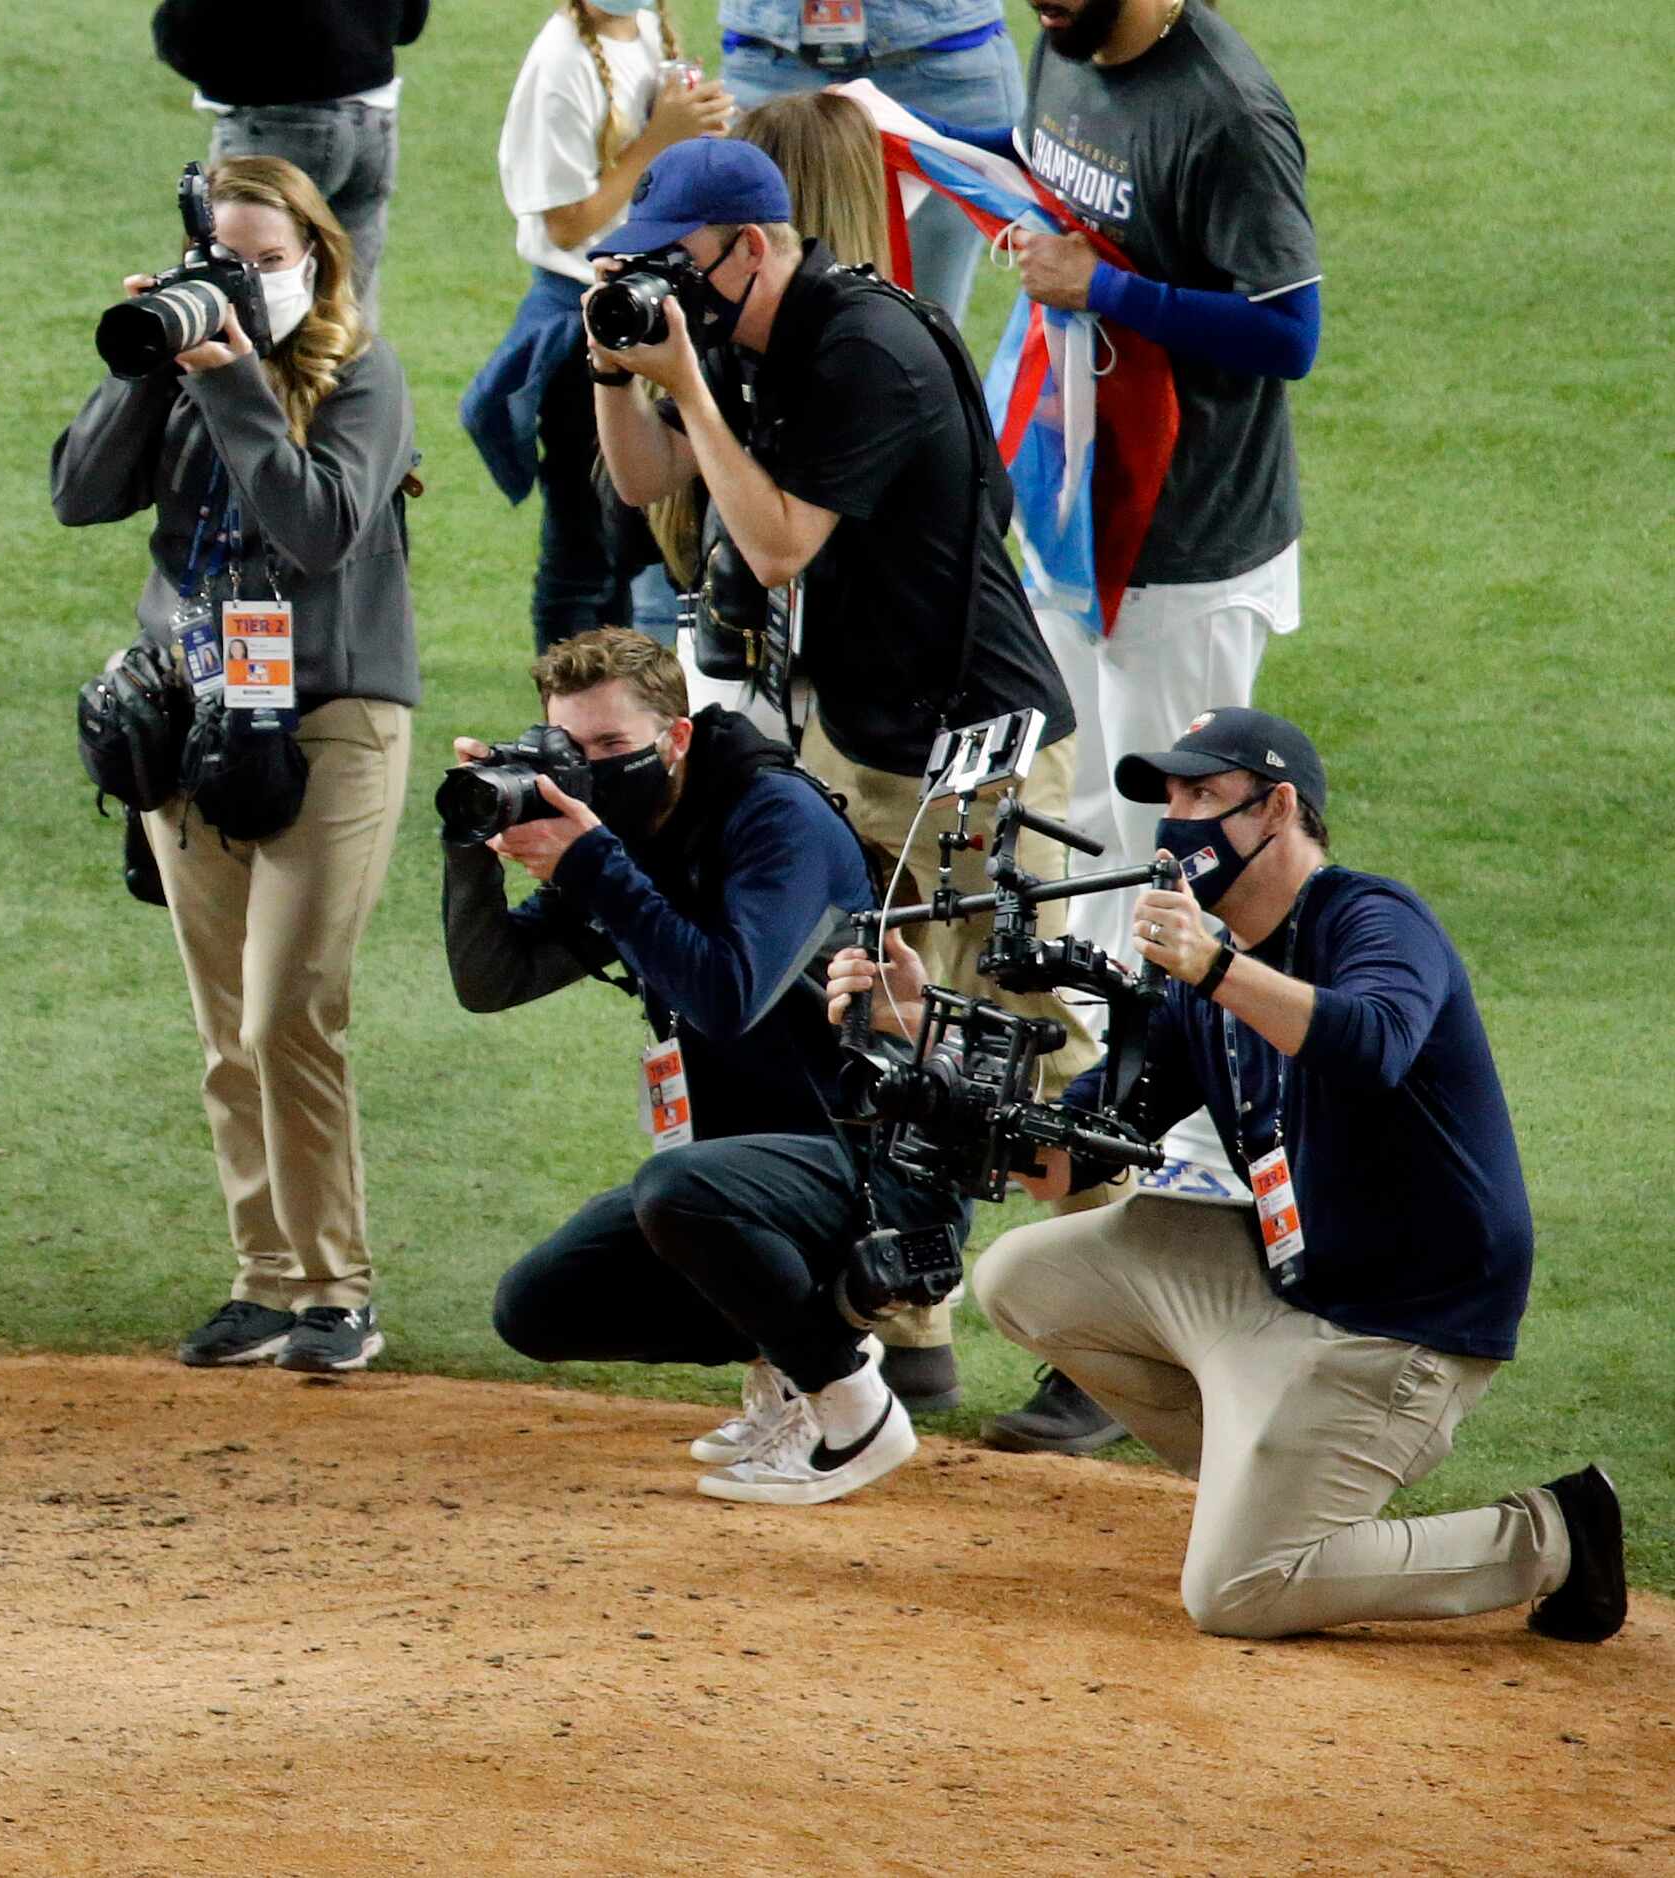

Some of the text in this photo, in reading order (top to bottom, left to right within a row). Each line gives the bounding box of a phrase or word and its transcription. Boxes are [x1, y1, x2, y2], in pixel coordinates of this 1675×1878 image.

[1032, 127, 1134, 220] CHAMPIONS
[232, 619, 285, 633] TIER 2
